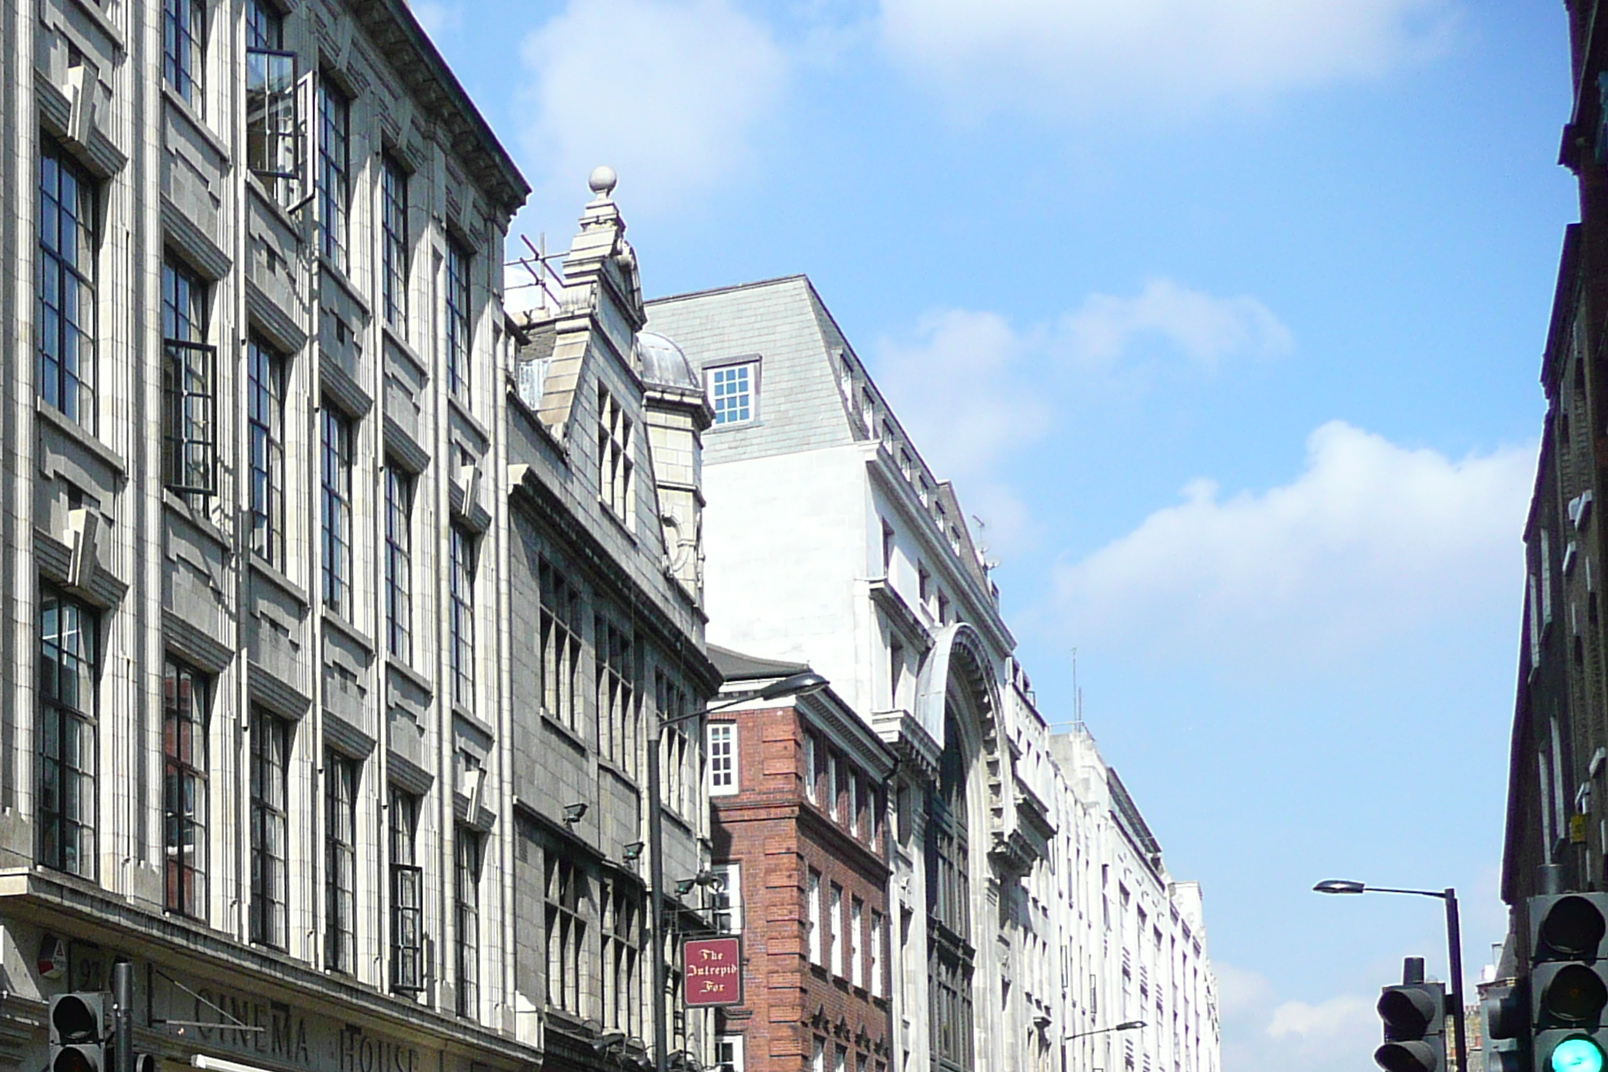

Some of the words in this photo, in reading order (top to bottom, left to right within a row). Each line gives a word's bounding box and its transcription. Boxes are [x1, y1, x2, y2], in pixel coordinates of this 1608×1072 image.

[700, 949, 723, 961] The
[687, 964, 737, 978] Intrepid
[700, 980, 725, 993] Fox
[194, 988, 311, 1066] CINEMA
